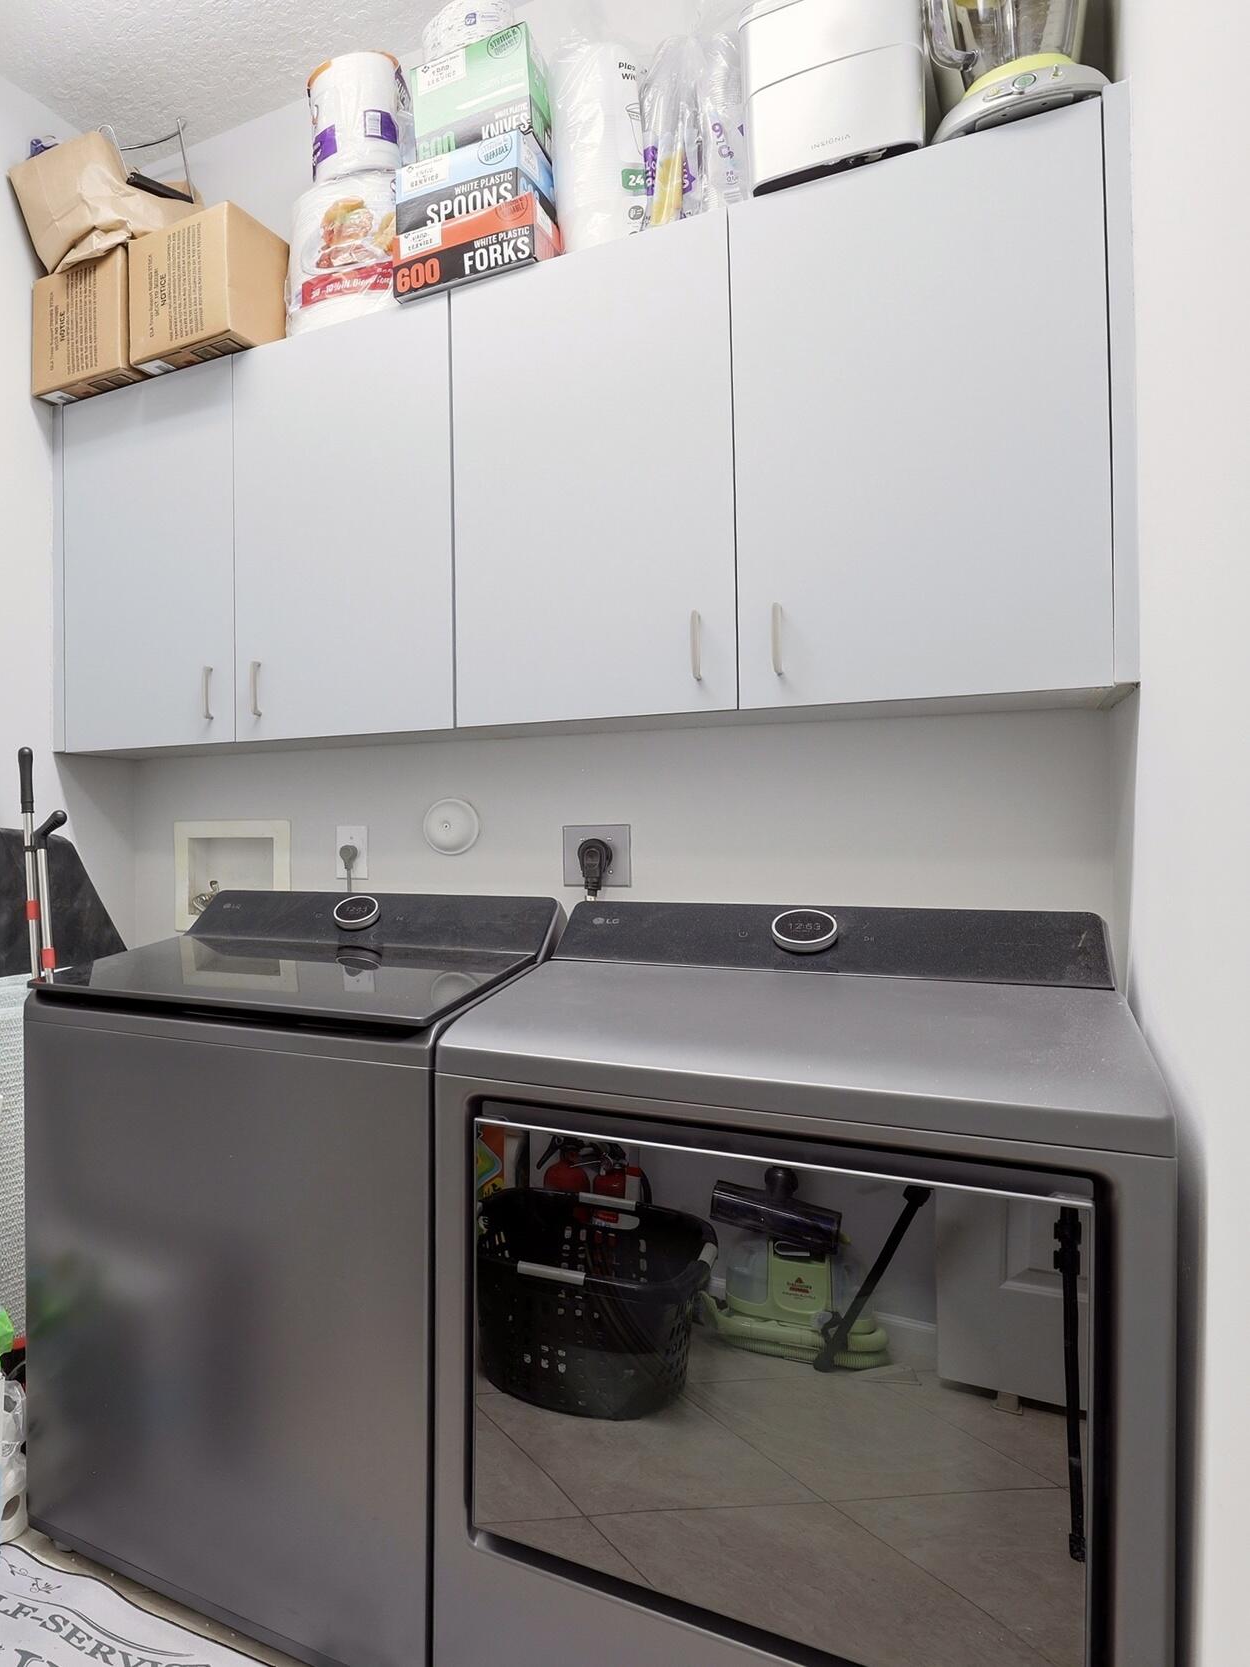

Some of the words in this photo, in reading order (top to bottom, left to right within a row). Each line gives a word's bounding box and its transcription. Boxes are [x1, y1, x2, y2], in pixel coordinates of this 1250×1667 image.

[481, 112, 531, 140] KNIVES
[455, 180, 480, 195] WHITE
[480, 171, 513, 188] PLASTIC
[426, 183, 512, 226] SPOONS
[474, 234, 498, 249] WHITE
[499, 227, 530, 241] PLASTIC
[463, 237, 531, 275] FORKS
[159, 273, 168, 307] NOTICE
[396, 258, 441, 293] 600
[59, 310, 67, 342] NOTICE
